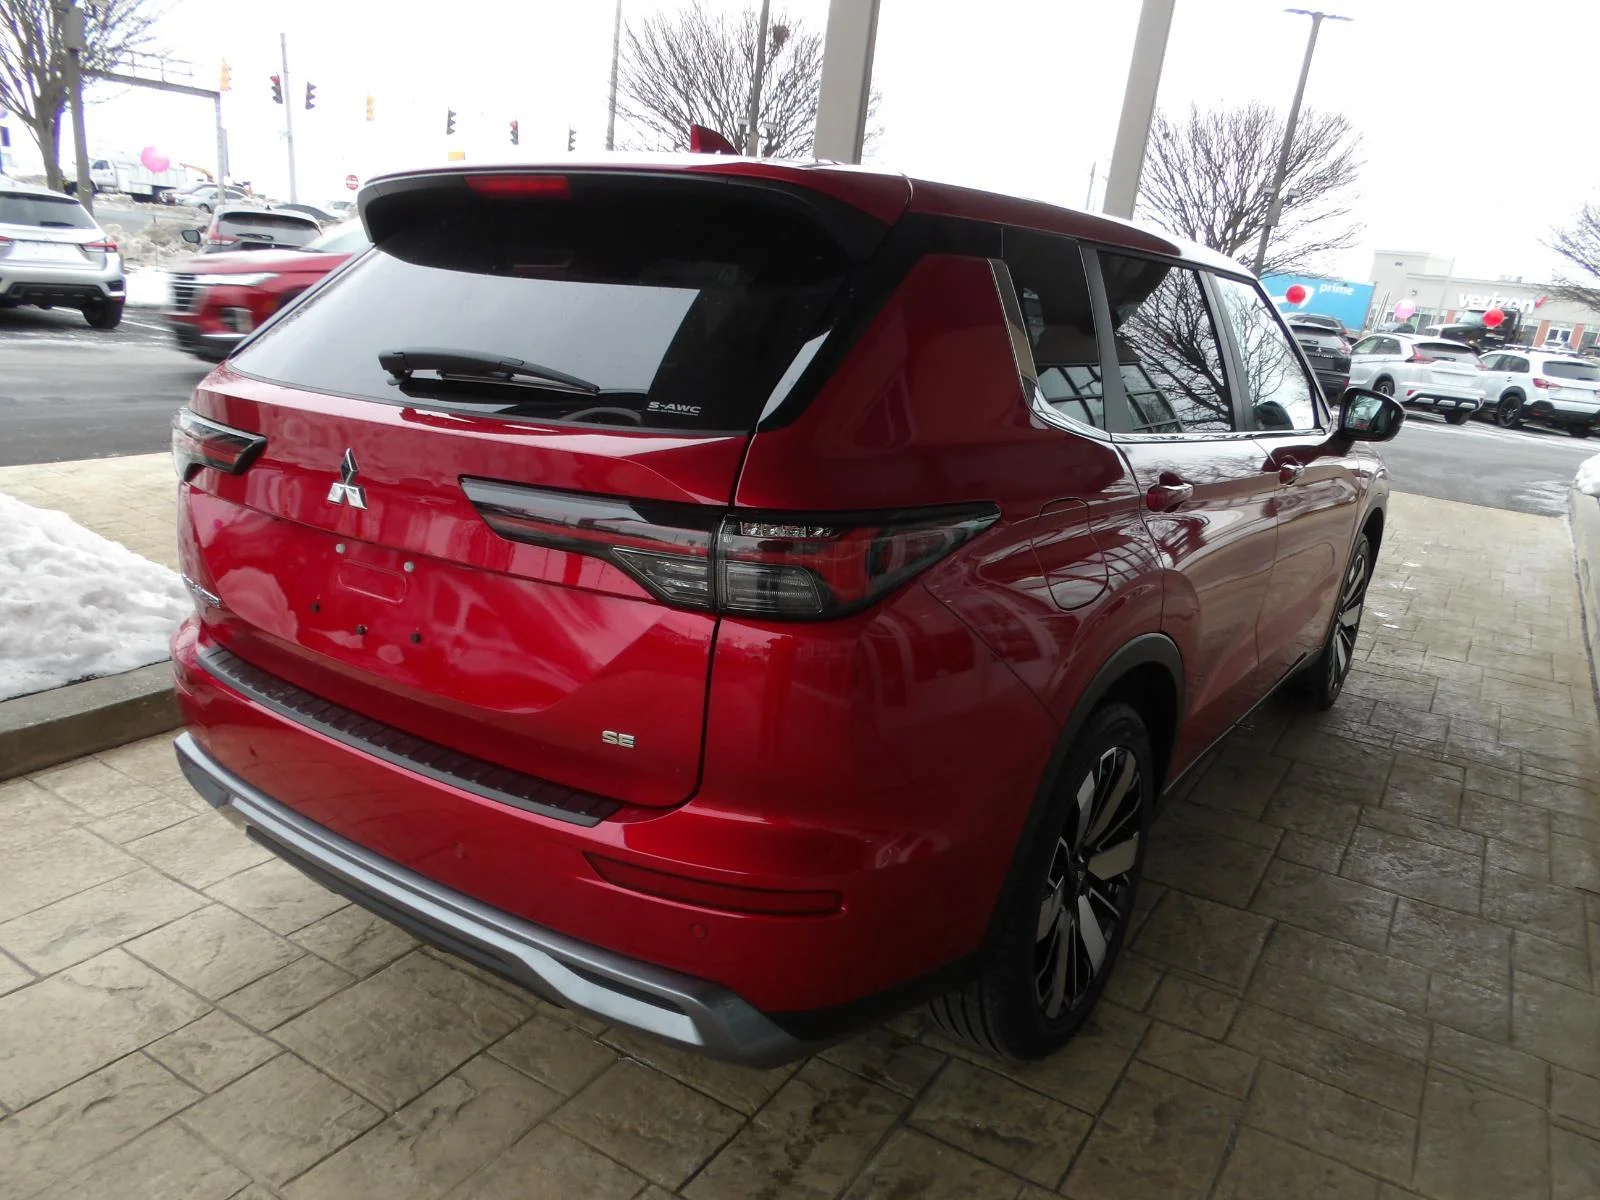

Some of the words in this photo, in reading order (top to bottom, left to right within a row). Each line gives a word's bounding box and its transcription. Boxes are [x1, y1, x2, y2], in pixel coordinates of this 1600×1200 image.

[1319, 282, 1354, 296] prime
[1458, 292, 1536, 314] verizon
[647, 401, 701, 414] S-AWC
[602, 730, 635, 748] SE
